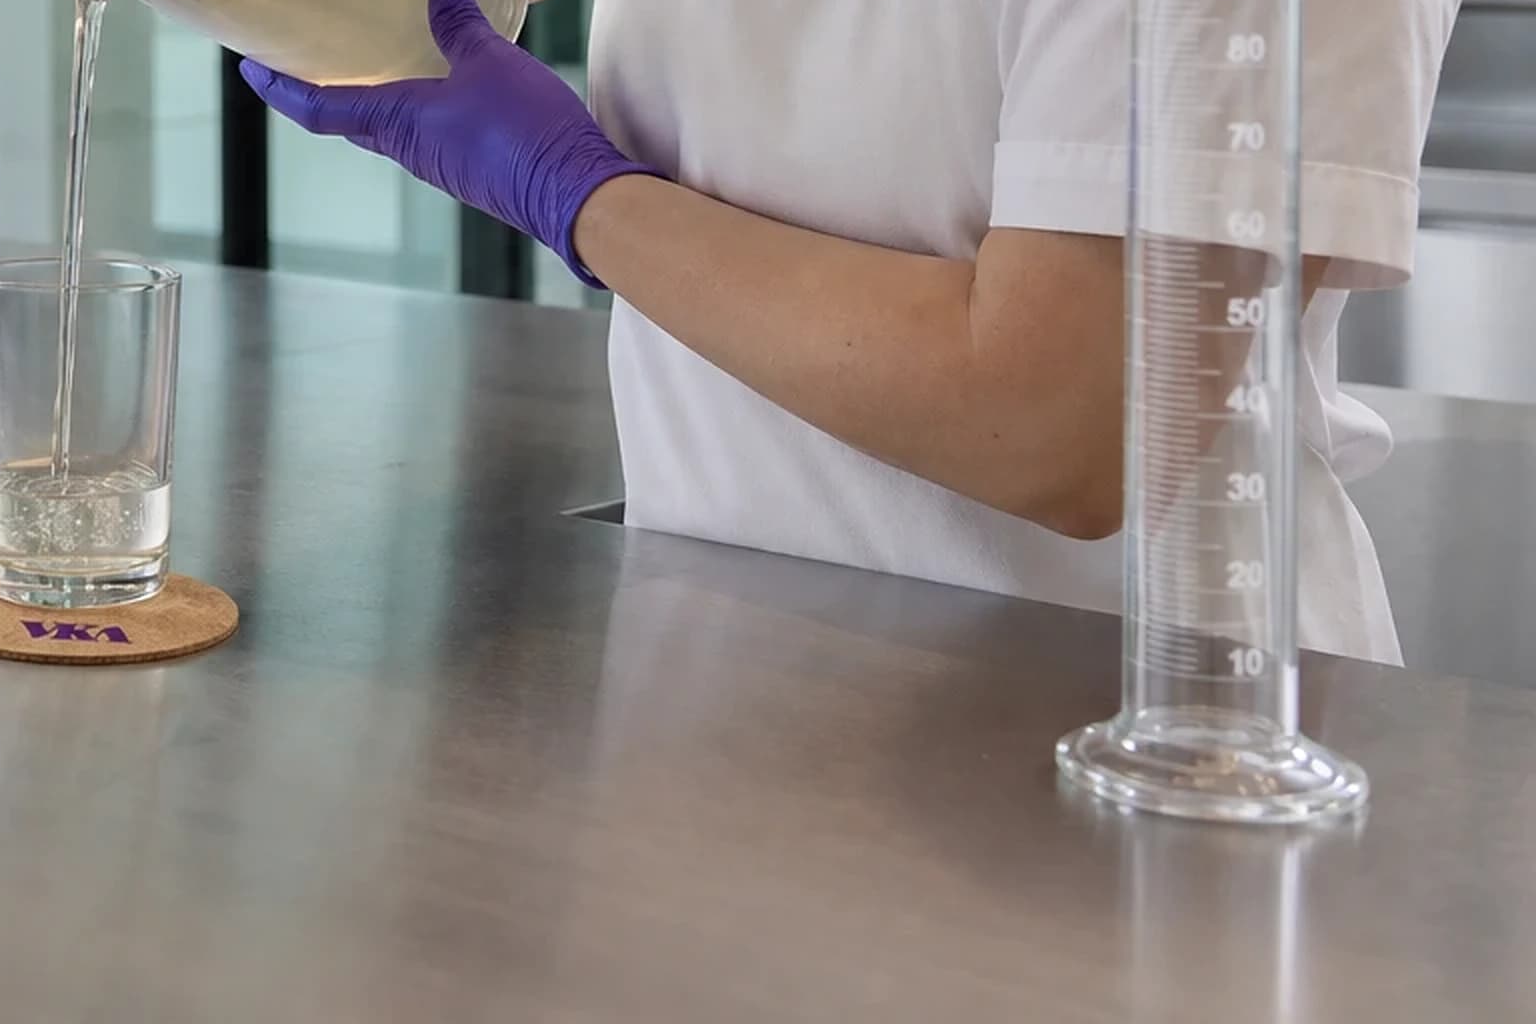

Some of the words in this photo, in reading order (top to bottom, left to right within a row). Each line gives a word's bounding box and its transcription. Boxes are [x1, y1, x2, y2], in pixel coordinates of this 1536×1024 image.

[1226, 34, 1266, 63] 80
[1226, 122, 1265, 152] 70
[1227, 210, 1265, 239] 60
[1225, 297, 1265, 327] 50
[1224, 385, 1266, 413] 40
[1226, 472, 1266, 501] 30
[1226, 560, 1264, 588] 20
[1227, 647, 1265, 676] 10
